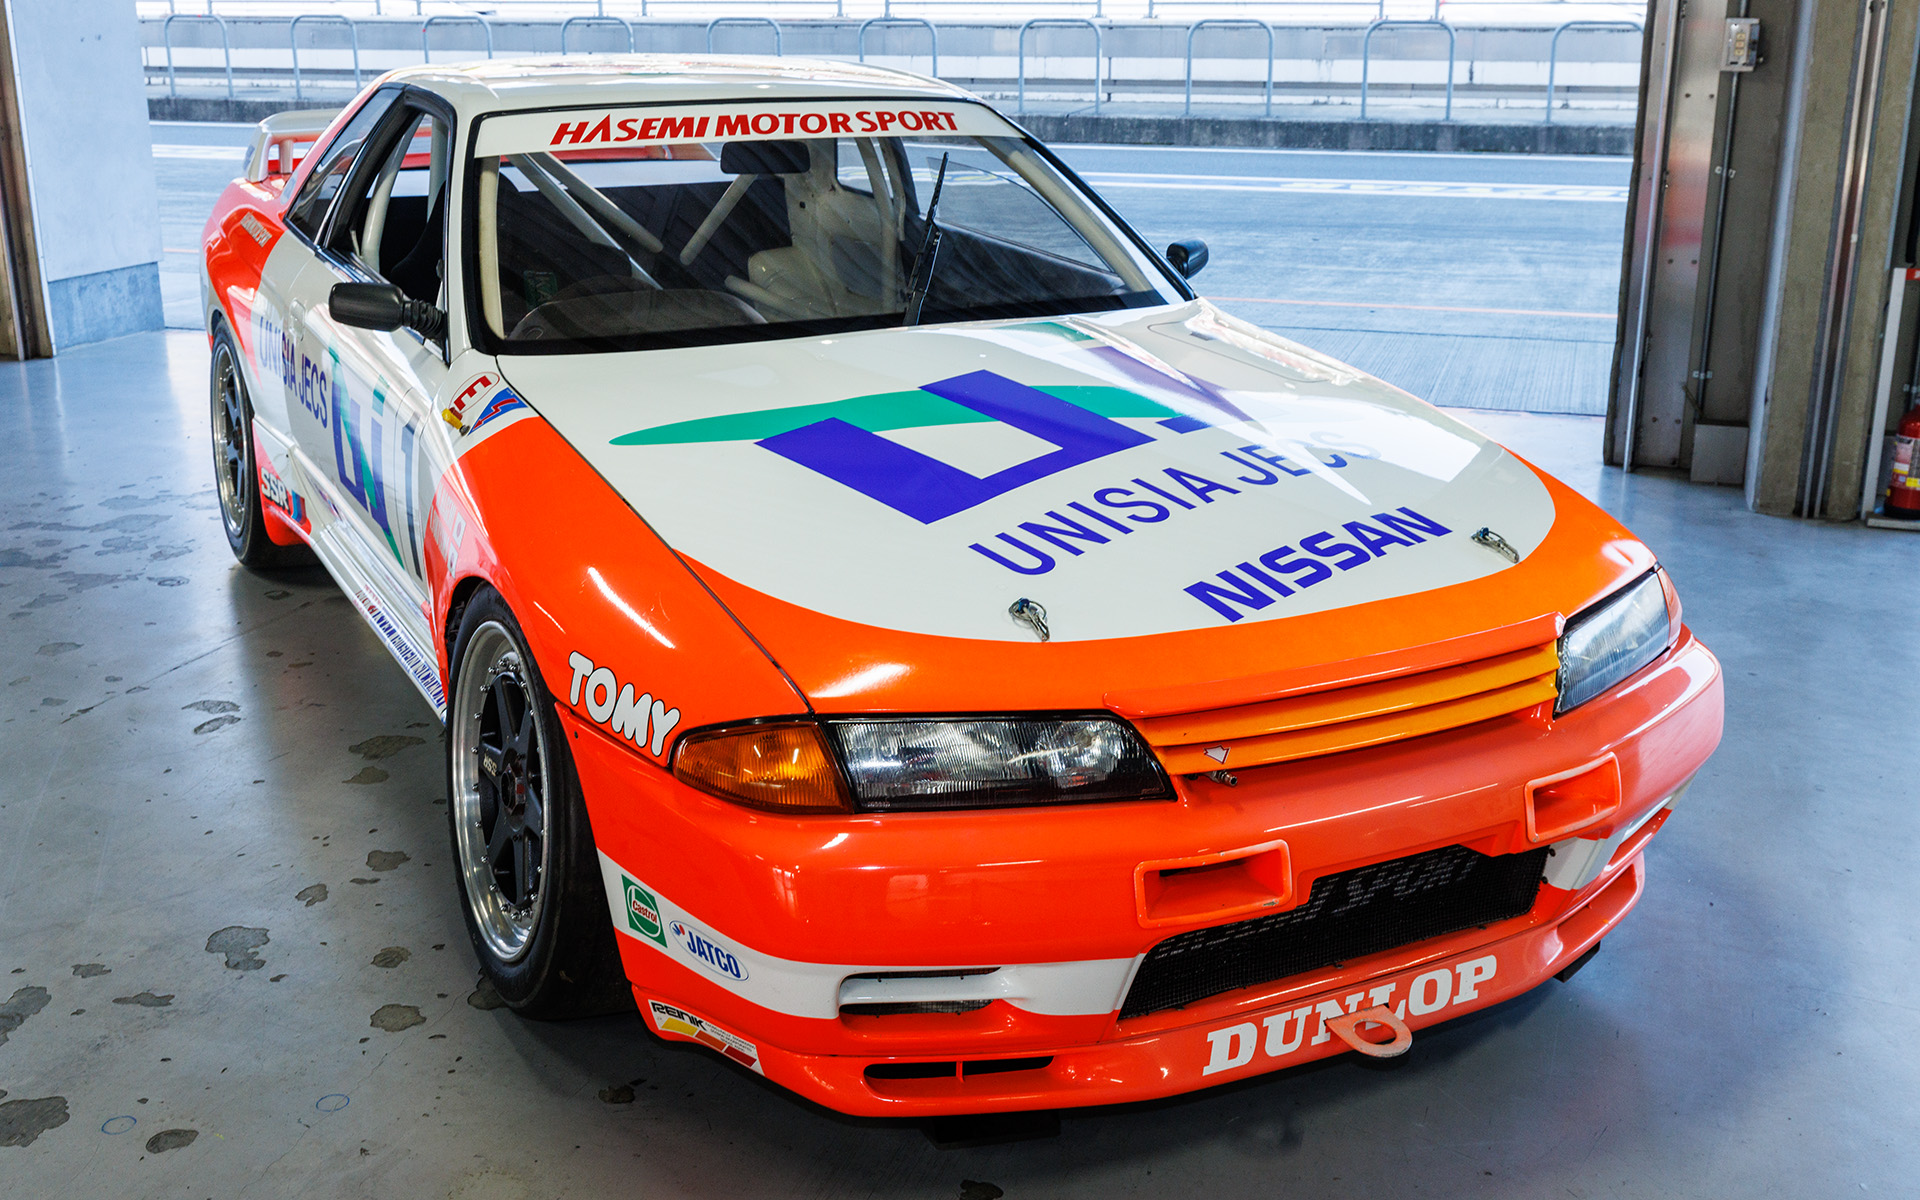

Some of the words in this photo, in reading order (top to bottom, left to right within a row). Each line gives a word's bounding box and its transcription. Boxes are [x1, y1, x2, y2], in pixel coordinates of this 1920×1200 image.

[549, 114, 711, 146] HASEMI
[259, 316, 298, 397] UNISIA
[299, 353, 328, 429] JECS
[260, 466, 291, 515] SSR
[968, 467, 1242, 575] UNISIA
[1219, 430, 1381, 486] JECS
[1183, 506, 1453, 623] NISSAN
[568, 650, 681, 757] TOMY
[632, 900, 658, 923] Castrol
[686, 930, 741, 979] JATCO
[651, 1001, 707, 1032] REINIK
[1202, 954, 1498, 1077] DUNLOP
